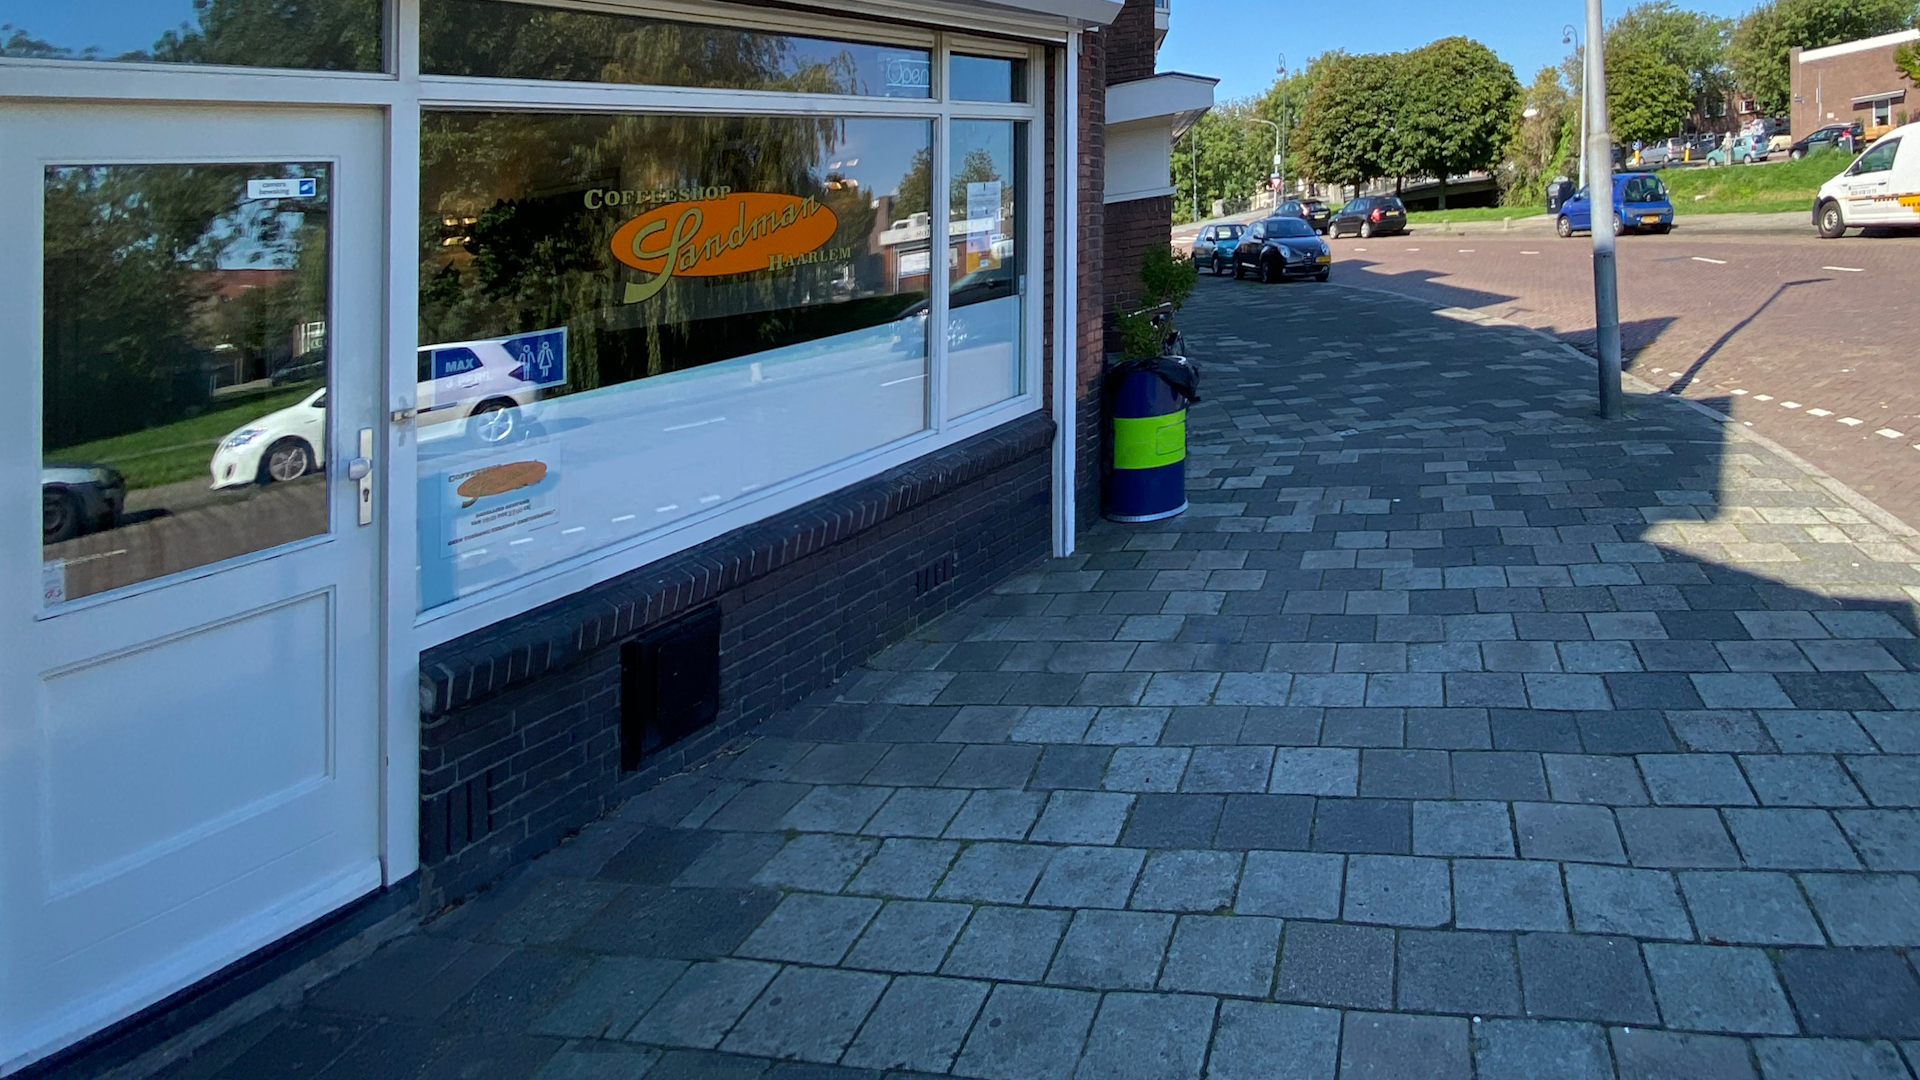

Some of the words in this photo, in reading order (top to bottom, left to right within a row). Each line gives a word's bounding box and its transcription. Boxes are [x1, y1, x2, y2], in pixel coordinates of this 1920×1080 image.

[887, 59, 929, 86] Open
[583, 185, 731, 210] COFFEESHOP
[767, 247, 852, 272] HAARLEM
[445, 357, 475, 373] MAX
